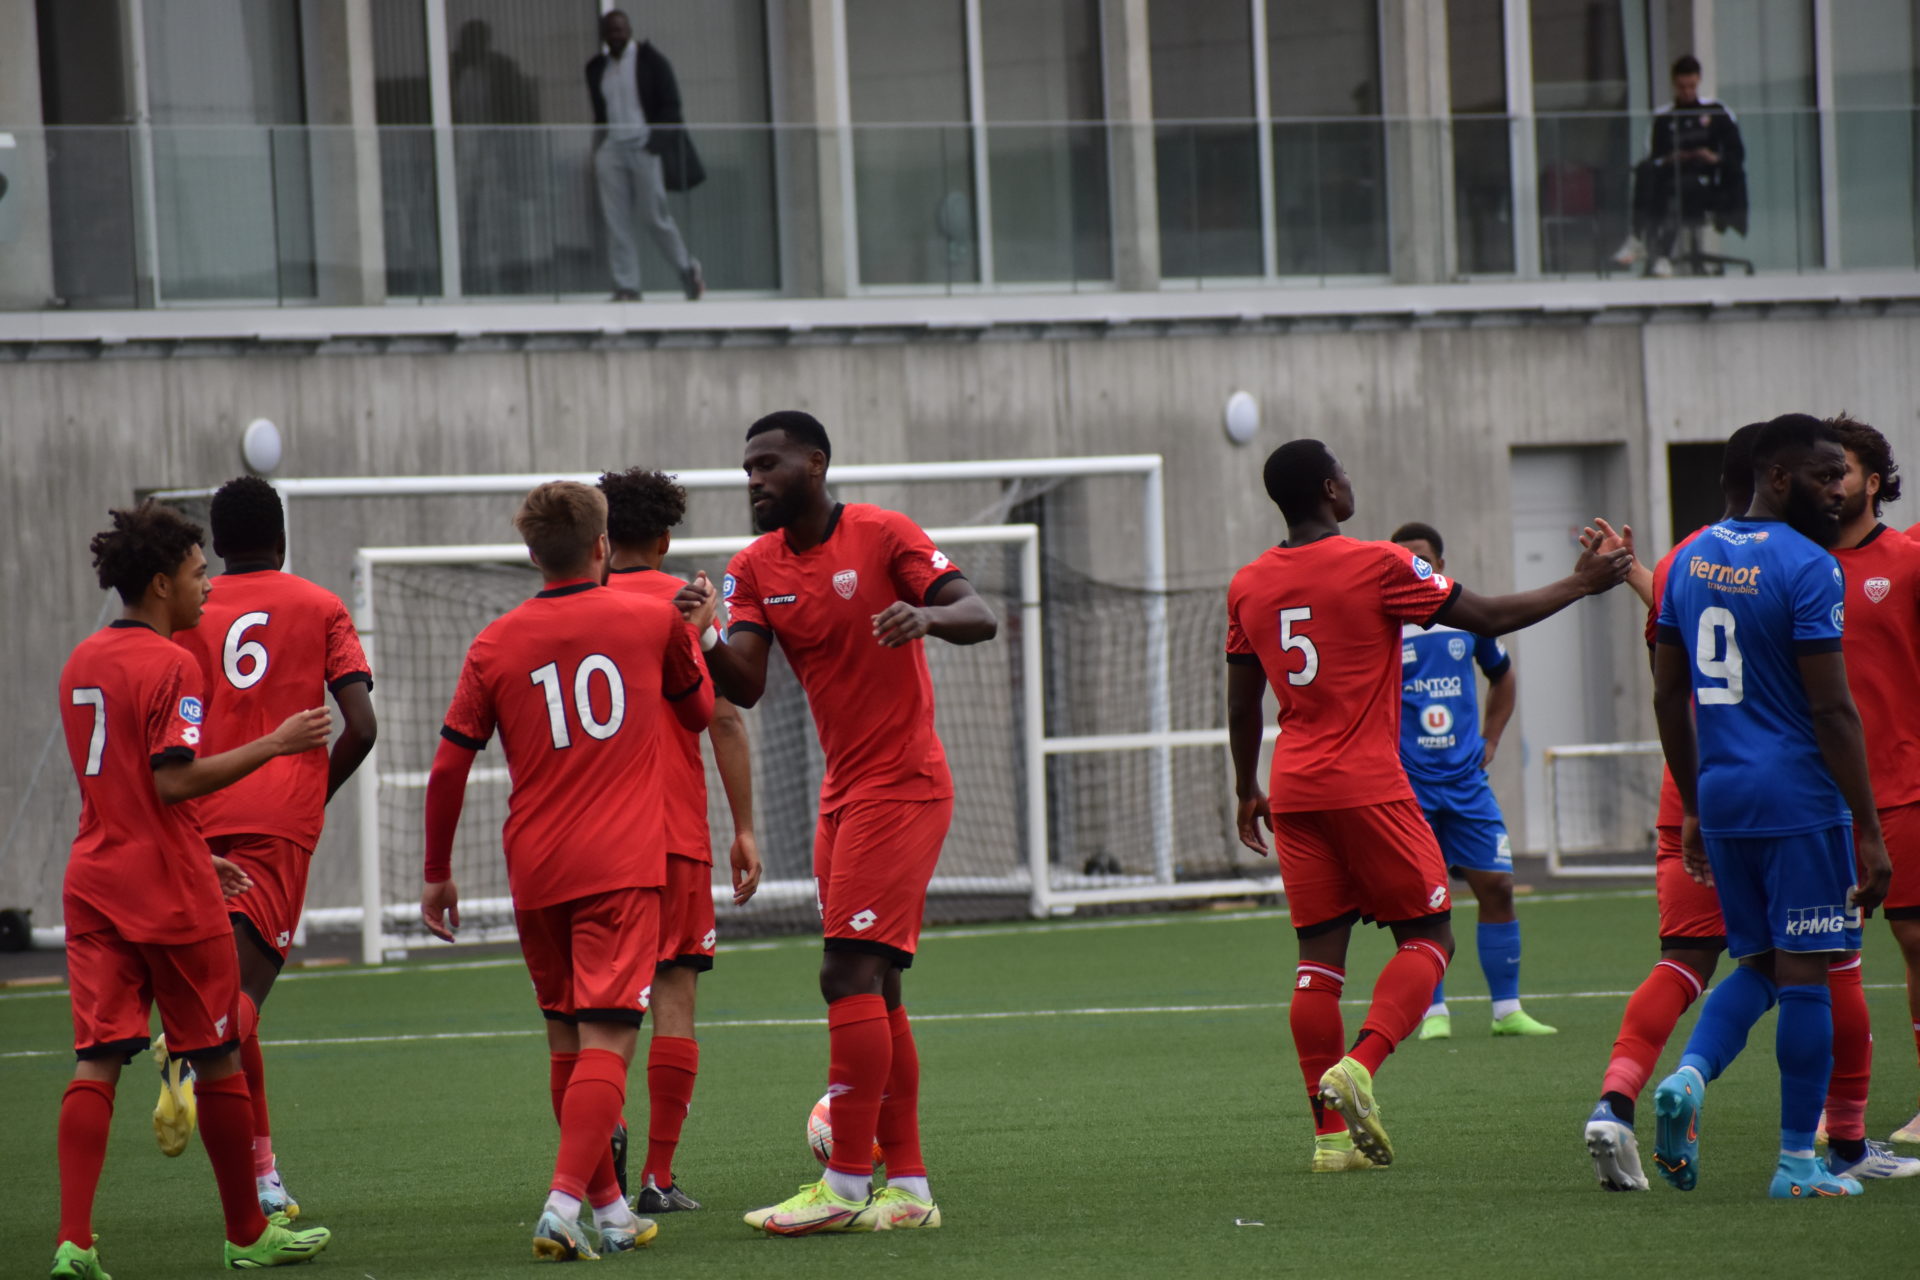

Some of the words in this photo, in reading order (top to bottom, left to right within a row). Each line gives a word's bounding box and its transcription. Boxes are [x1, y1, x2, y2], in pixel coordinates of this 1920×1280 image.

[1712, 525, 1737, 538] SPORT
[1689, 556, 1761, 586] Vermot
[769, 595, 797, 605] LOTTO
[222, 611, 270, 690] 6
[1279, 605, 1320, 687] 5
[1697, 606, 1744, 705] 9
[183, 701, 201, 718] N3
[529, 653, 626, 750] 10
[71, 686, 107, 776] 7
[1786, 915, 1845, 936] KPMG
